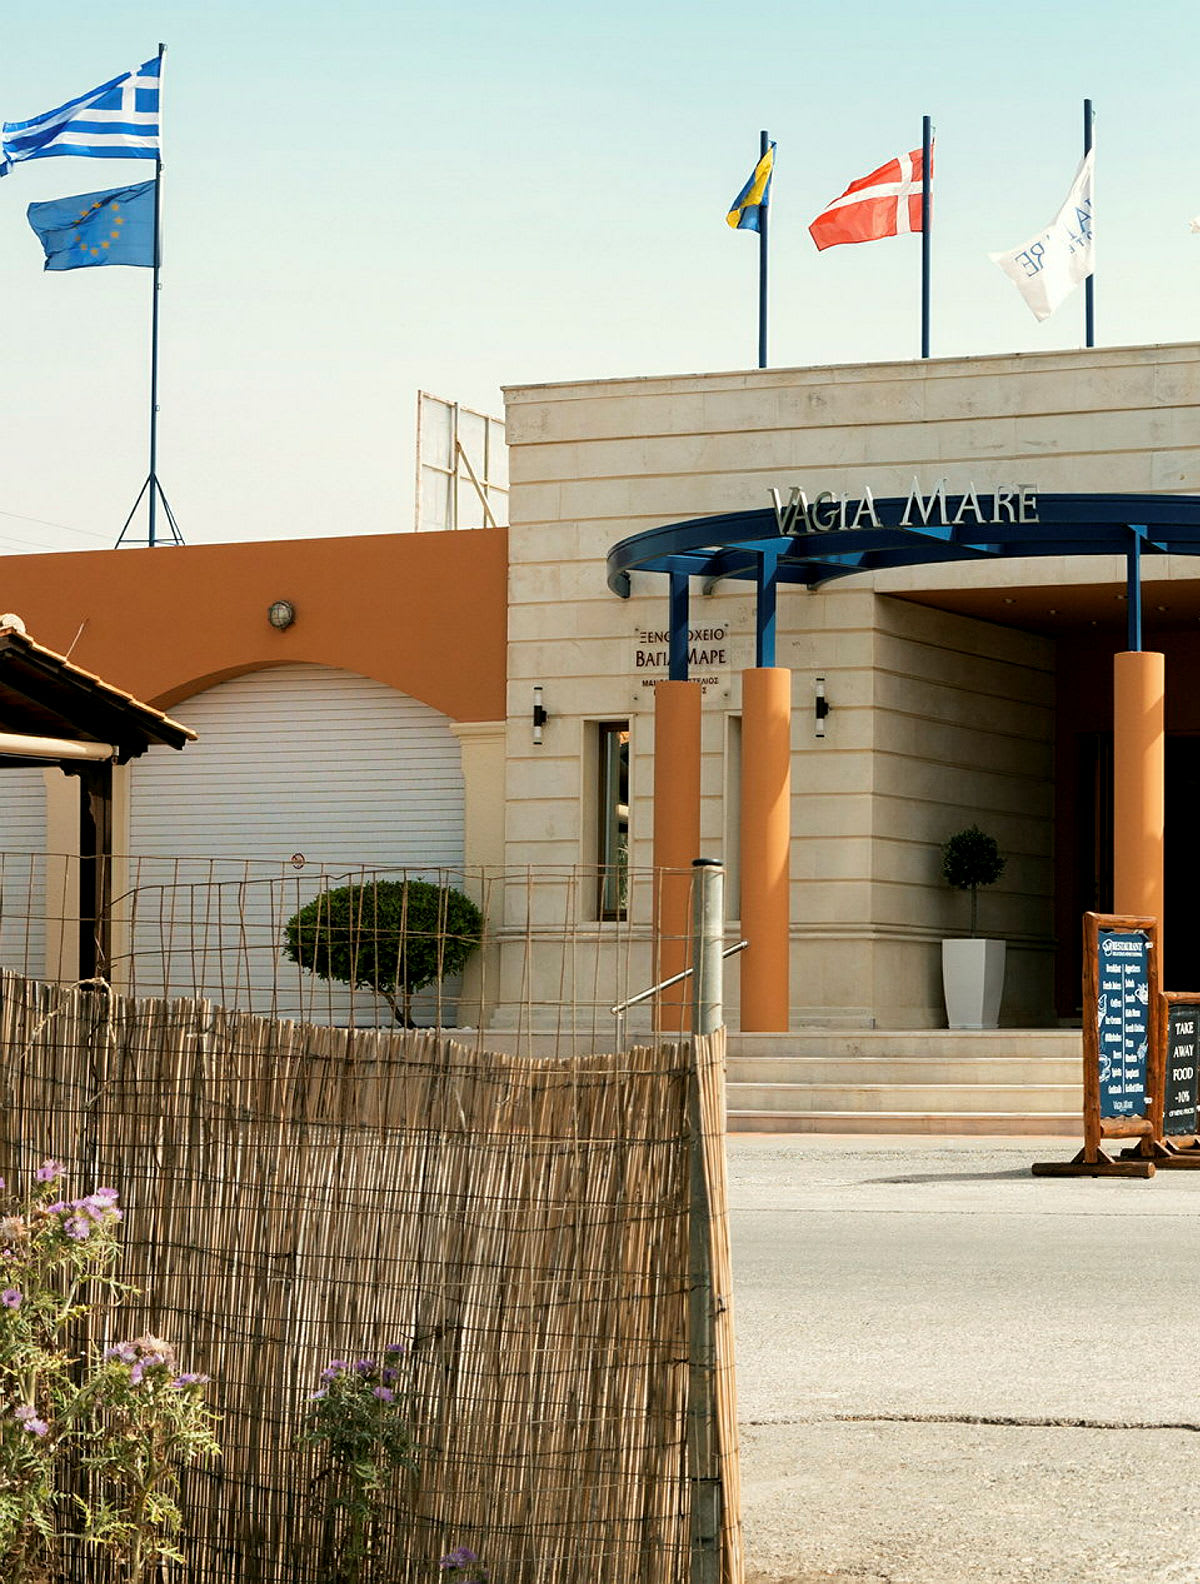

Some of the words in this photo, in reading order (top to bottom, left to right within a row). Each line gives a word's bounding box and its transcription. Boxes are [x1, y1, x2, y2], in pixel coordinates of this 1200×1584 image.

[767, 485, 883, 536] VAGIA
[900, 475, 1040, 526] MARE
[640, 628, 725, 644] ΞΕΝΟΟΧΕΙΟ
[636, 650, 670, 667] ΒΑΓΙ
[1175, 1021, 1194, 1036] TAKE
[1173, 1044, 1195, 1059] AWAY
[1172, 1066, 1194, 1081] FOOD
[1174, 1090, 1190, 1103] -10%
